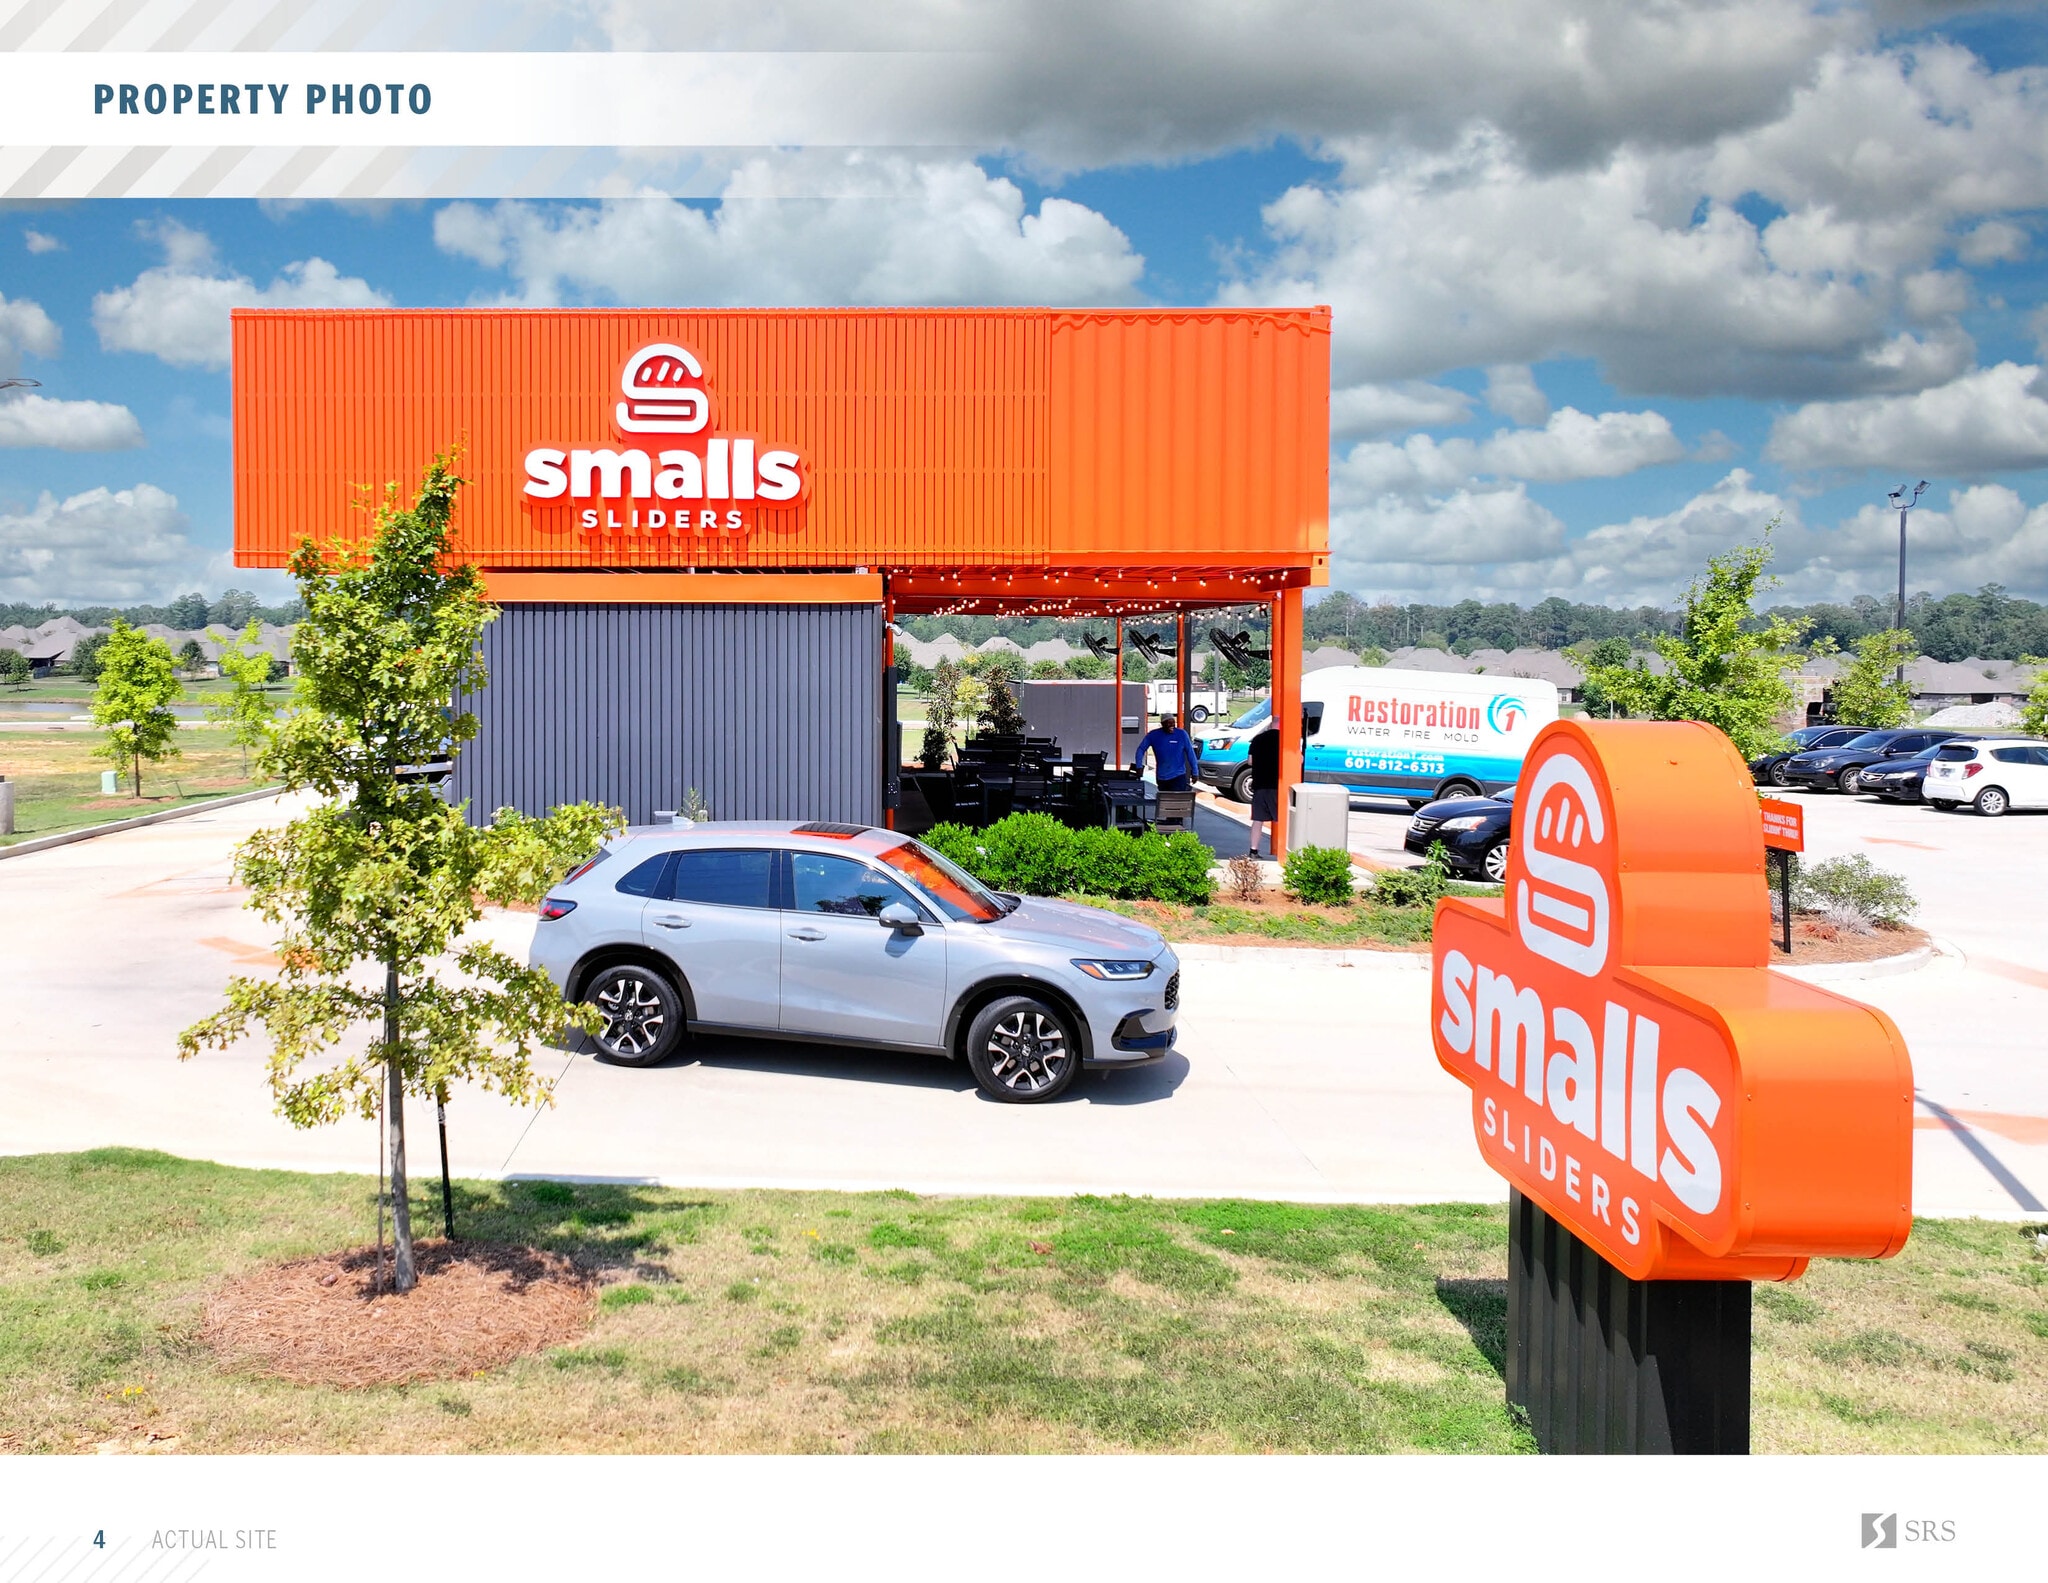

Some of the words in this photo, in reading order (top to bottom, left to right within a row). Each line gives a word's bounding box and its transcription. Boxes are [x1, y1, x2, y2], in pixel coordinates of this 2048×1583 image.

[523, 438, 801, 501] smalls
[582, 509, 743, 530] SLIDERS
[1348, 695, 1481, 730] Restoration
[1505, 710, 1516, 732] 1
[1347, 726, 1390, 737] WATER
[1404, 729, 1431, 740] FIRE
[1444, 732, 1479, 743] MOLD
[1344, 757, 1445, 774] 601-812-6313
[1346, 748, 1445, 762] restoration1.com
[1763, 811, 1785, 825] THANKS
[1786, 816, 1797, 827] FOR
[1440, 948, 1722, 1215] smalls
[1483, 1097, 1642, 1246] SLIDERS
